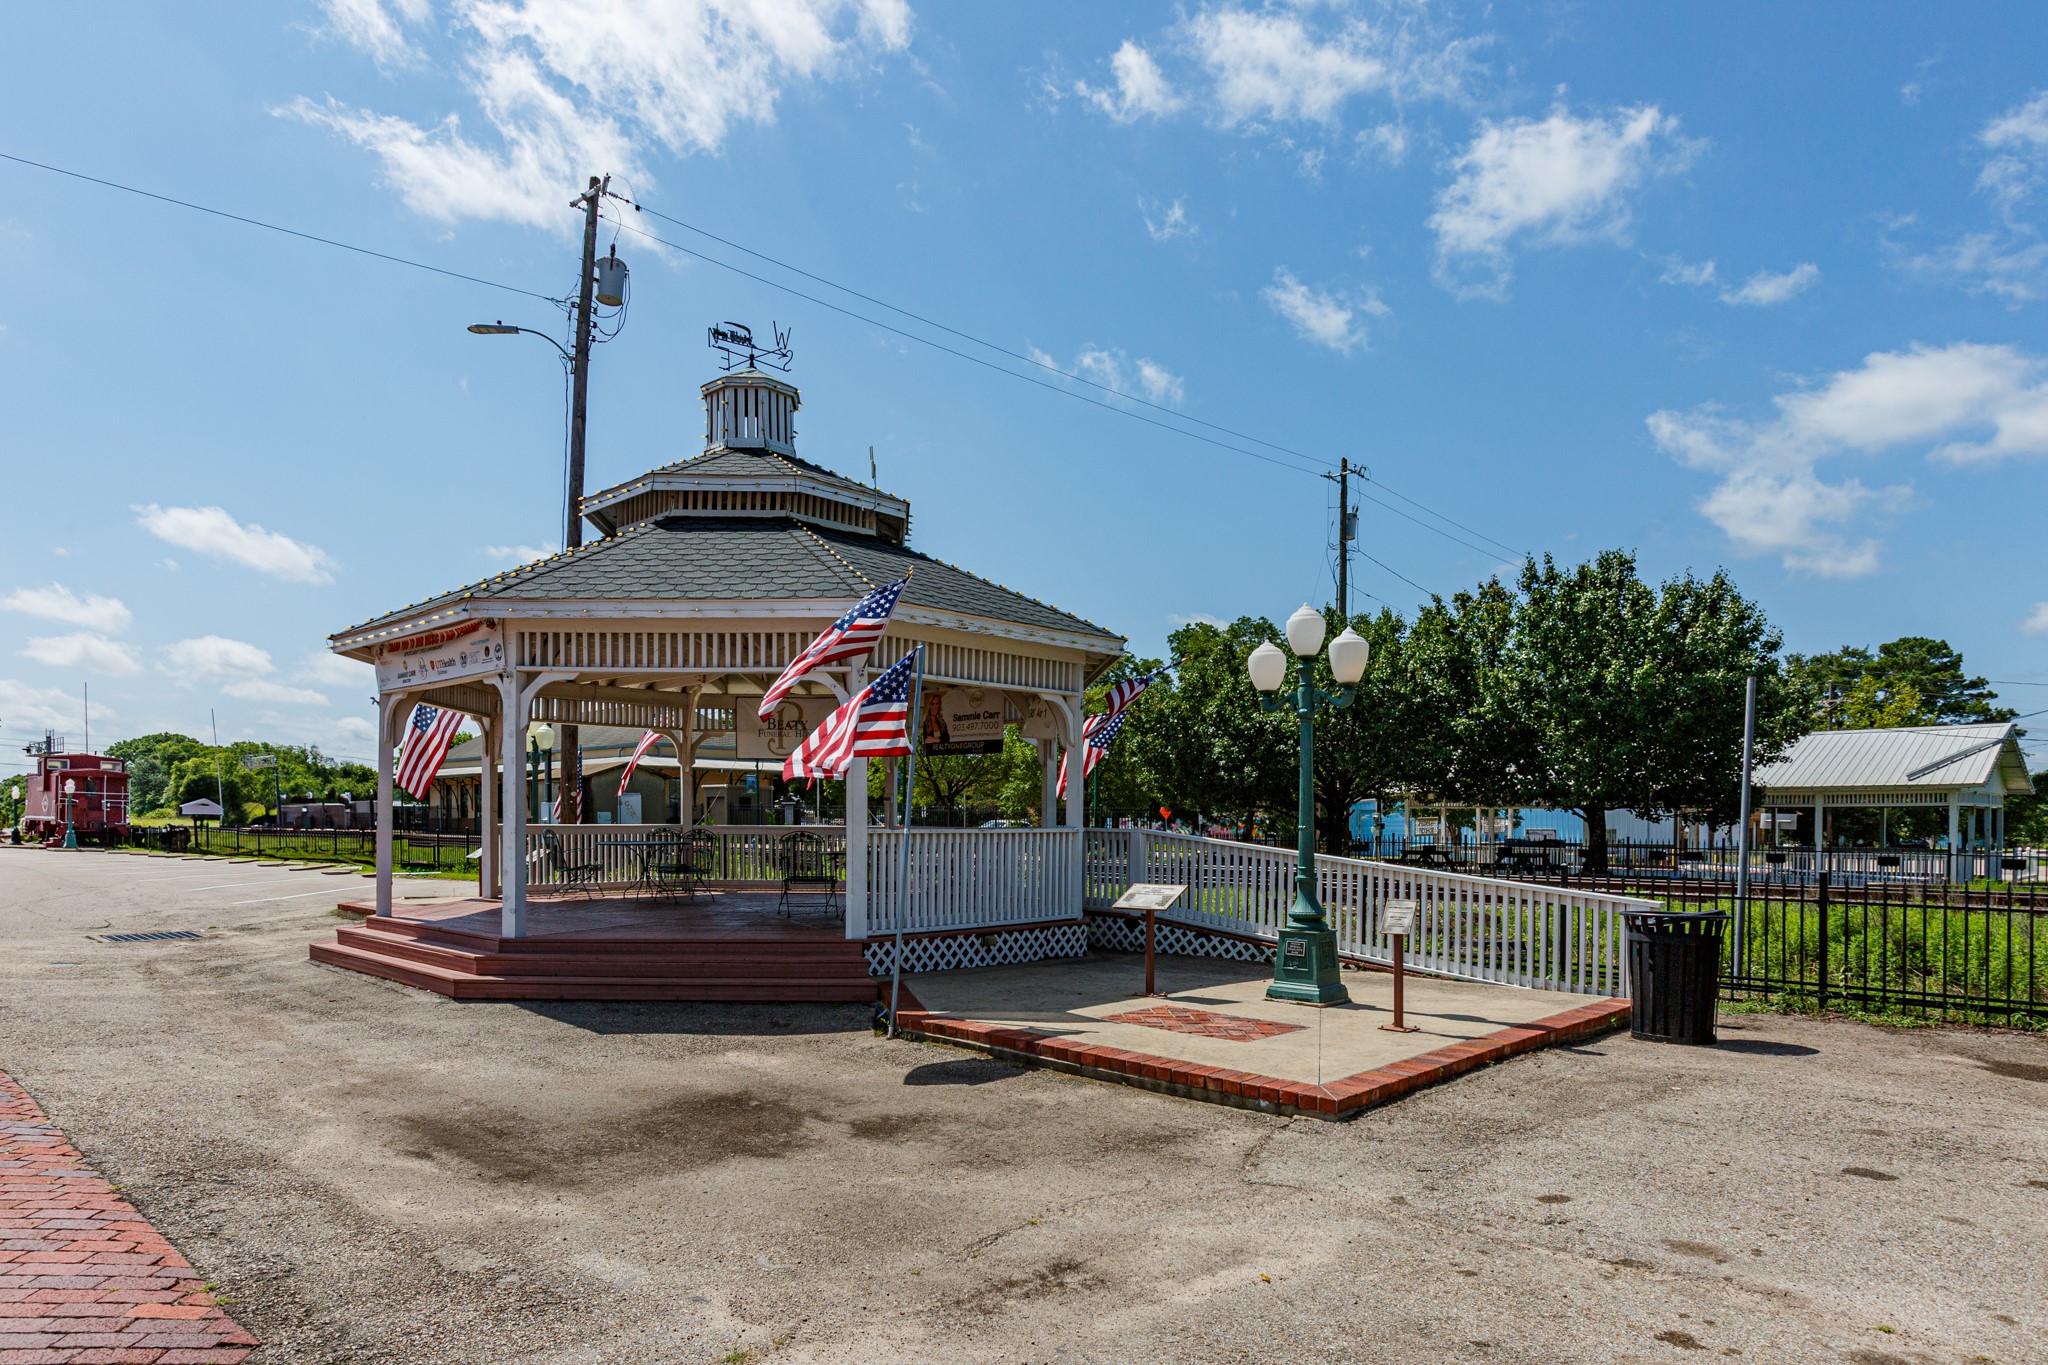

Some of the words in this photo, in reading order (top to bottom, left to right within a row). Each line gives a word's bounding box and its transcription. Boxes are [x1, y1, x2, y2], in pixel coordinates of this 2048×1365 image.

[400, 639, 410, 651] YOU
[952, 711, 981, 722] Sammie
[983, 710, 1000, 720] Carr
[767, 718, 808, 730] BEATY
[952, 721, 999, 732] 903.497.7000
[758, 729, 792, 738] FUNERAL
